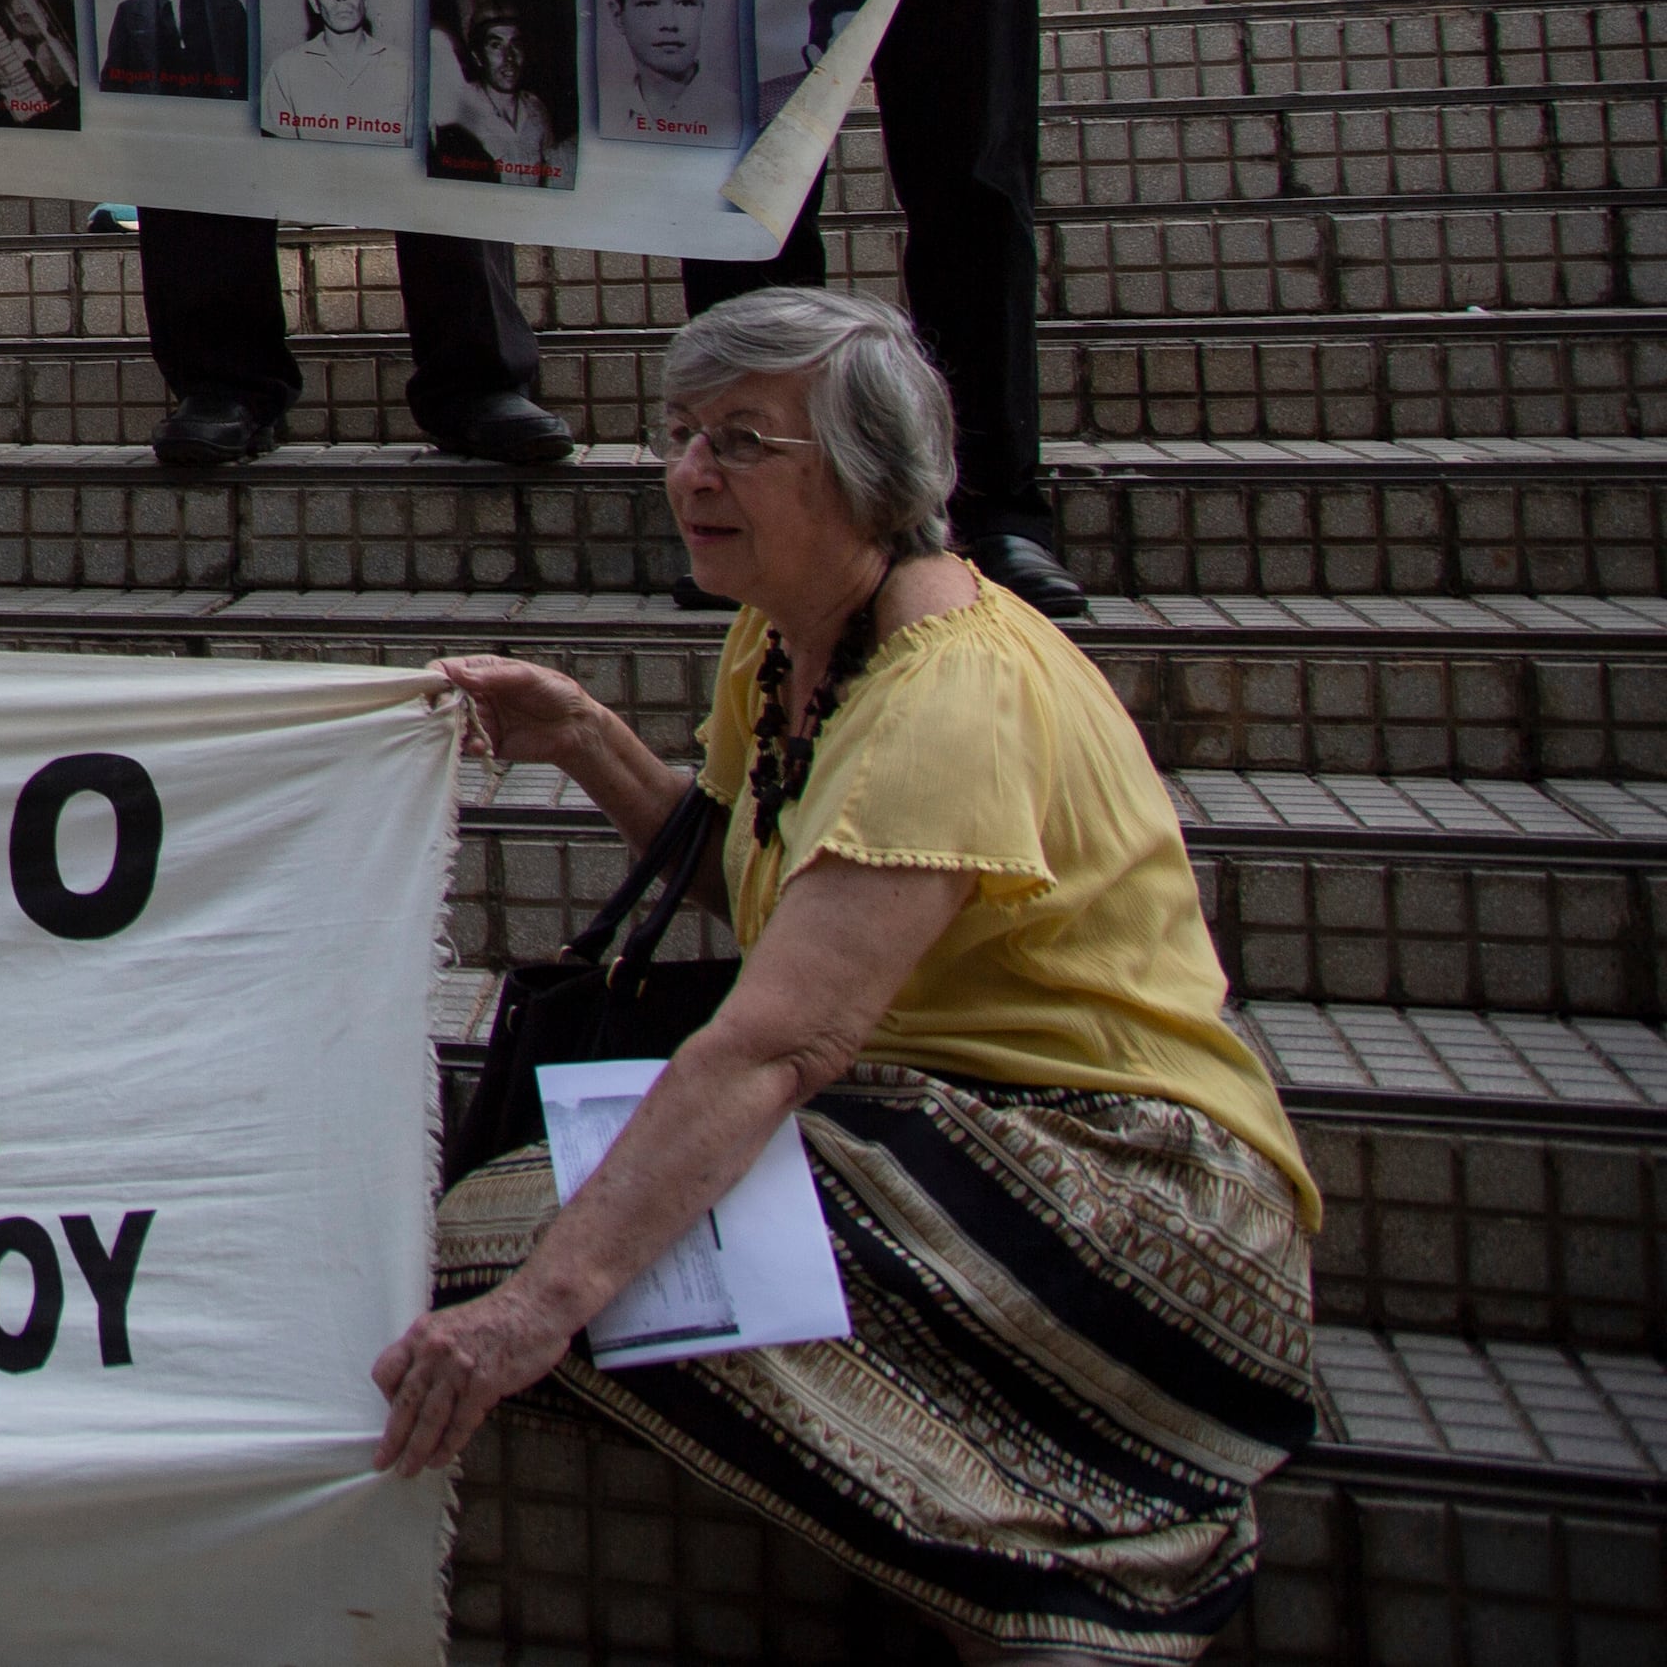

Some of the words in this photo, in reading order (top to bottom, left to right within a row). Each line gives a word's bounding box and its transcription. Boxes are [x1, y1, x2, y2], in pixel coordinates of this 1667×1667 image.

[278, 111, 339, 130] Ramón
[346, 115, 402, 134] Pintos
[636, 116, 652, 130] E.
[656, 118, 708, 135] Servín
